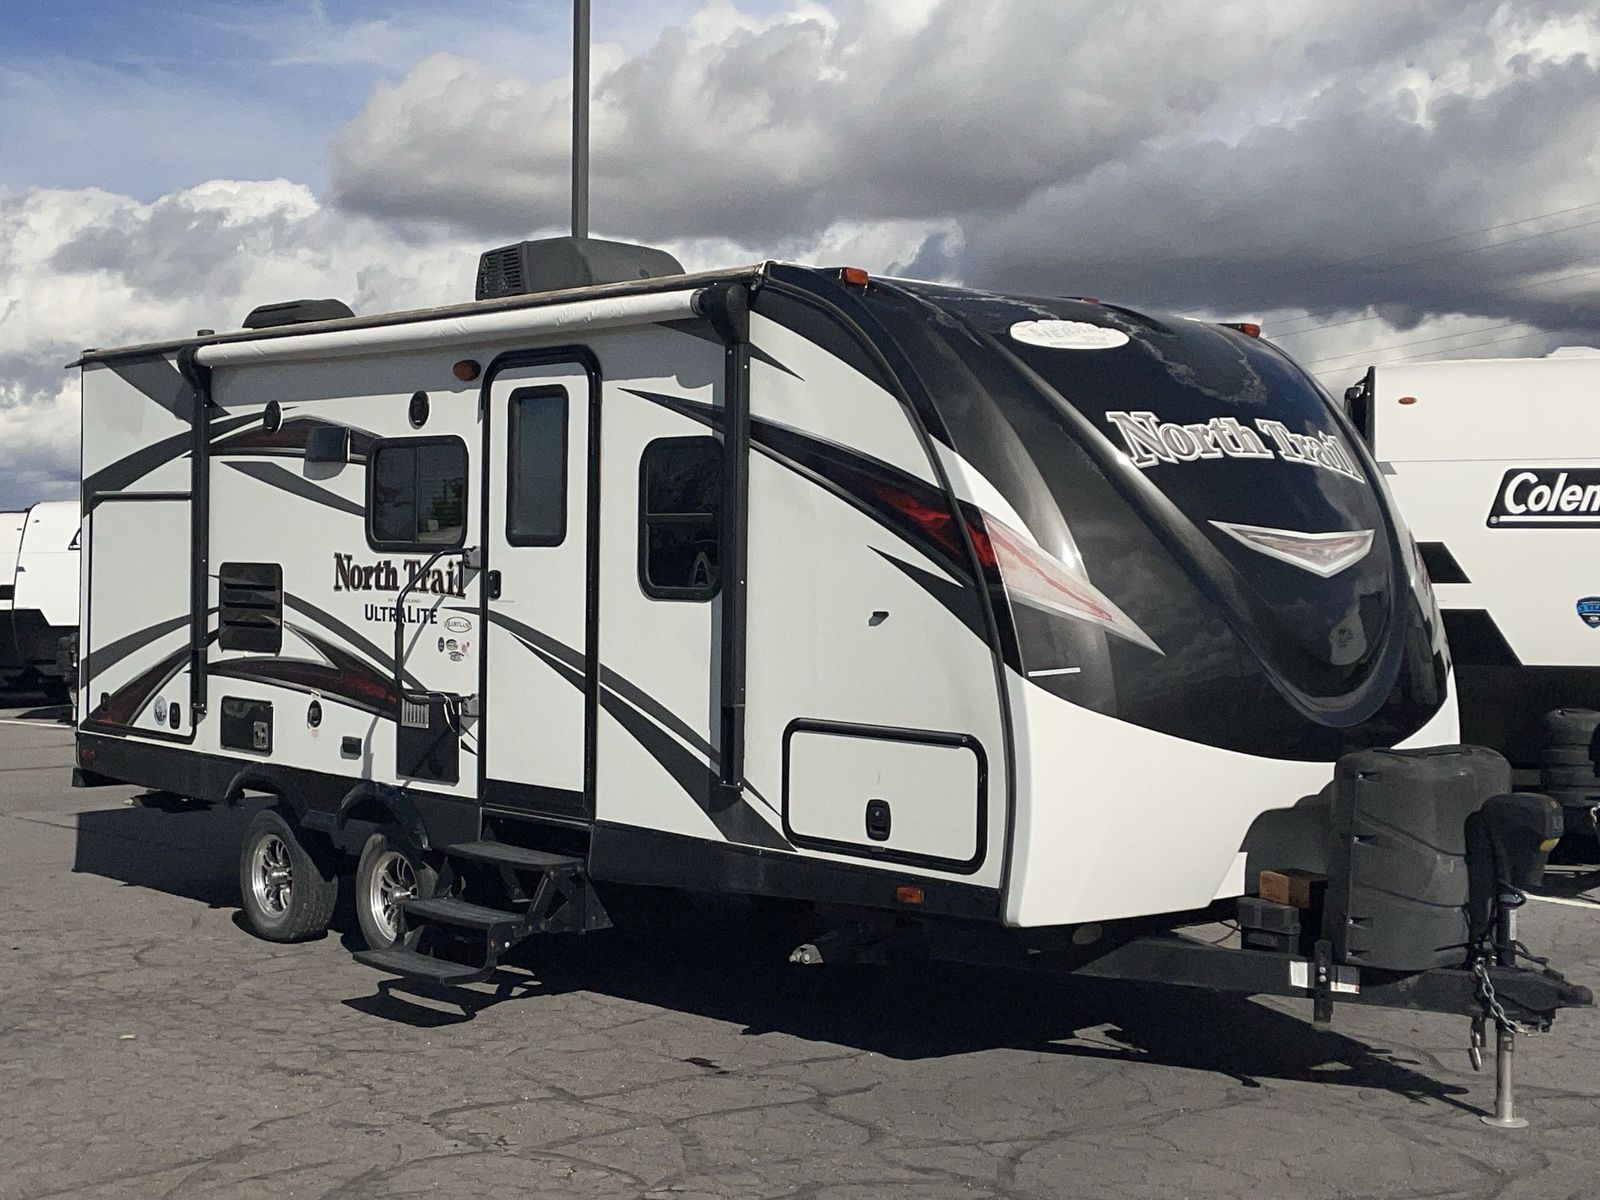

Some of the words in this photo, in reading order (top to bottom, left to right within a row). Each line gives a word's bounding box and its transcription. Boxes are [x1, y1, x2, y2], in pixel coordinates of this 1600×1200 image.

[1105, 411, 1275, 468] North
[1254, 418, 1365, 483] Trail
[333, 552, 400, 592] North
[403, 558, 466, 599] Trail
